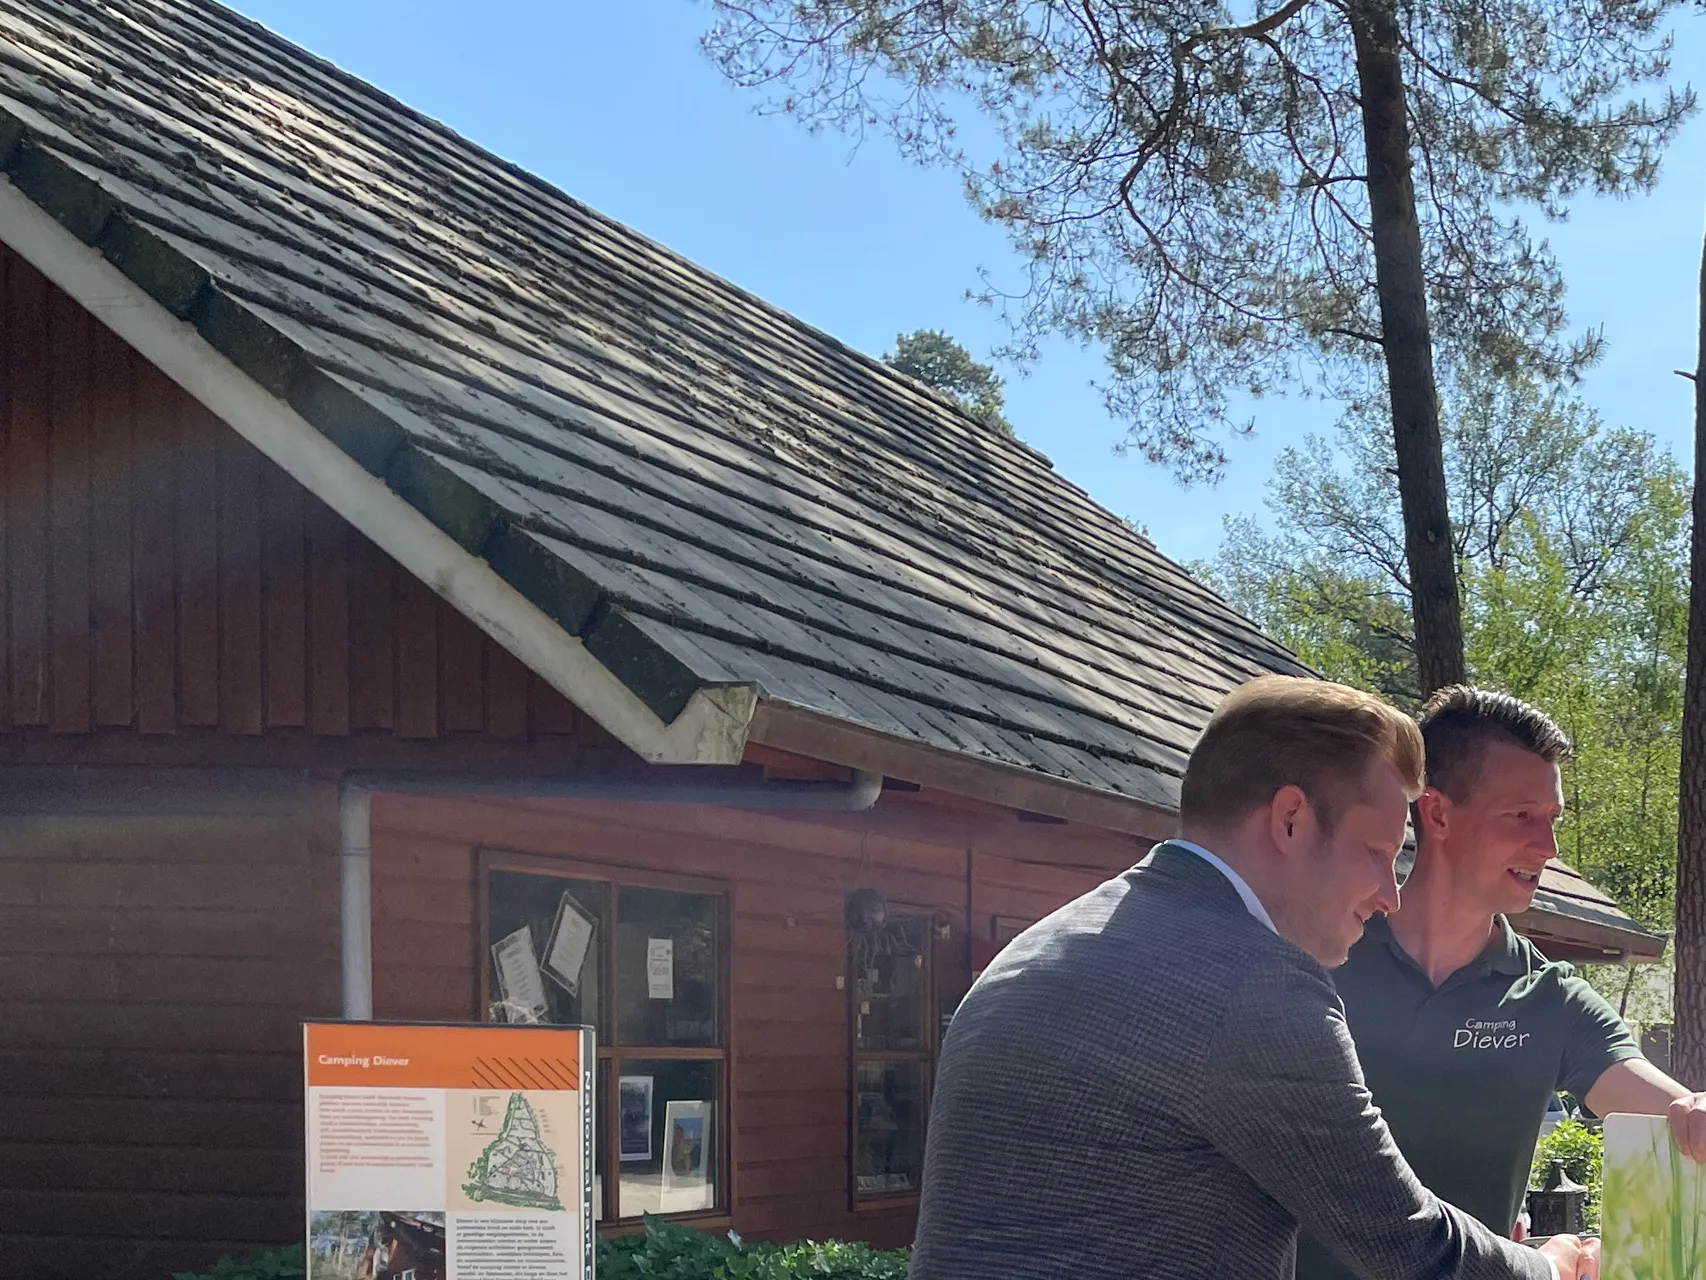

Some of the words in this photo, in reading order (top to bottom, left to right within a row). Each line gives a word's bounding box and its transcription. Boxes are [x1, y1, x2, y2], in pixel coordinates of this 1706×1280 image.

[1465, 1018, 1517, 1033] Camping
[1453, 1029, 1531, 1049] Diever
[318, 1054, 370, 1068] Camping
[373, 1055, 410, 1066] Diever
